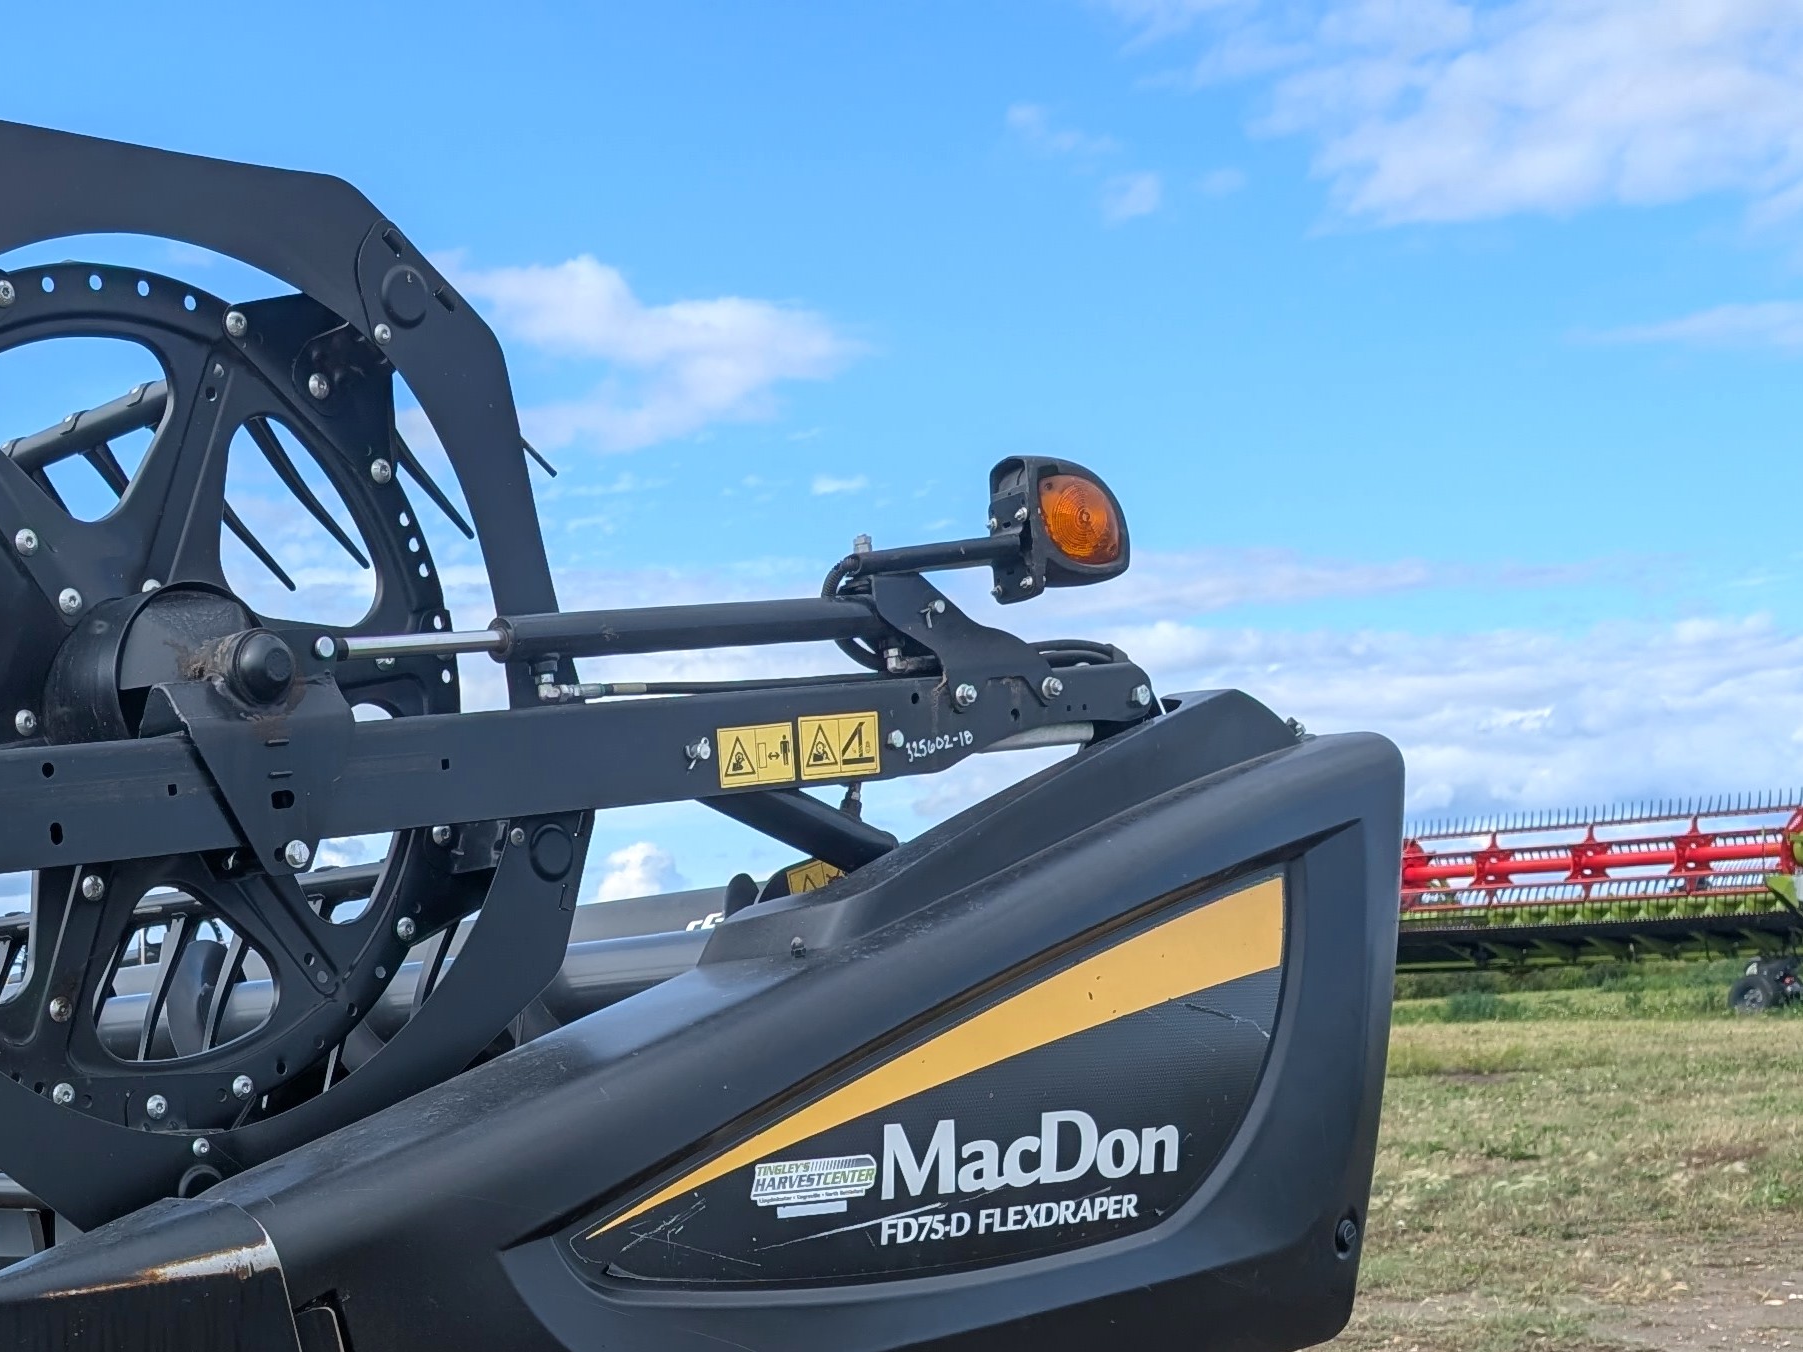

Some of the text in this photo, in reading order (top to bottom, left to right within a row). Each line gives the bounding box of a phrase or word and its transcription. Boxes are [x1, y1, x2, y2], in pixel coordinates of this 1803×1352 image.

[757, 1162, 811, 1177] TINGLEY'S
[881, 1110, 1179, 1201] MacDon
[880, 1193, 1140, 1246] FD75-D FLEXDRAPER
